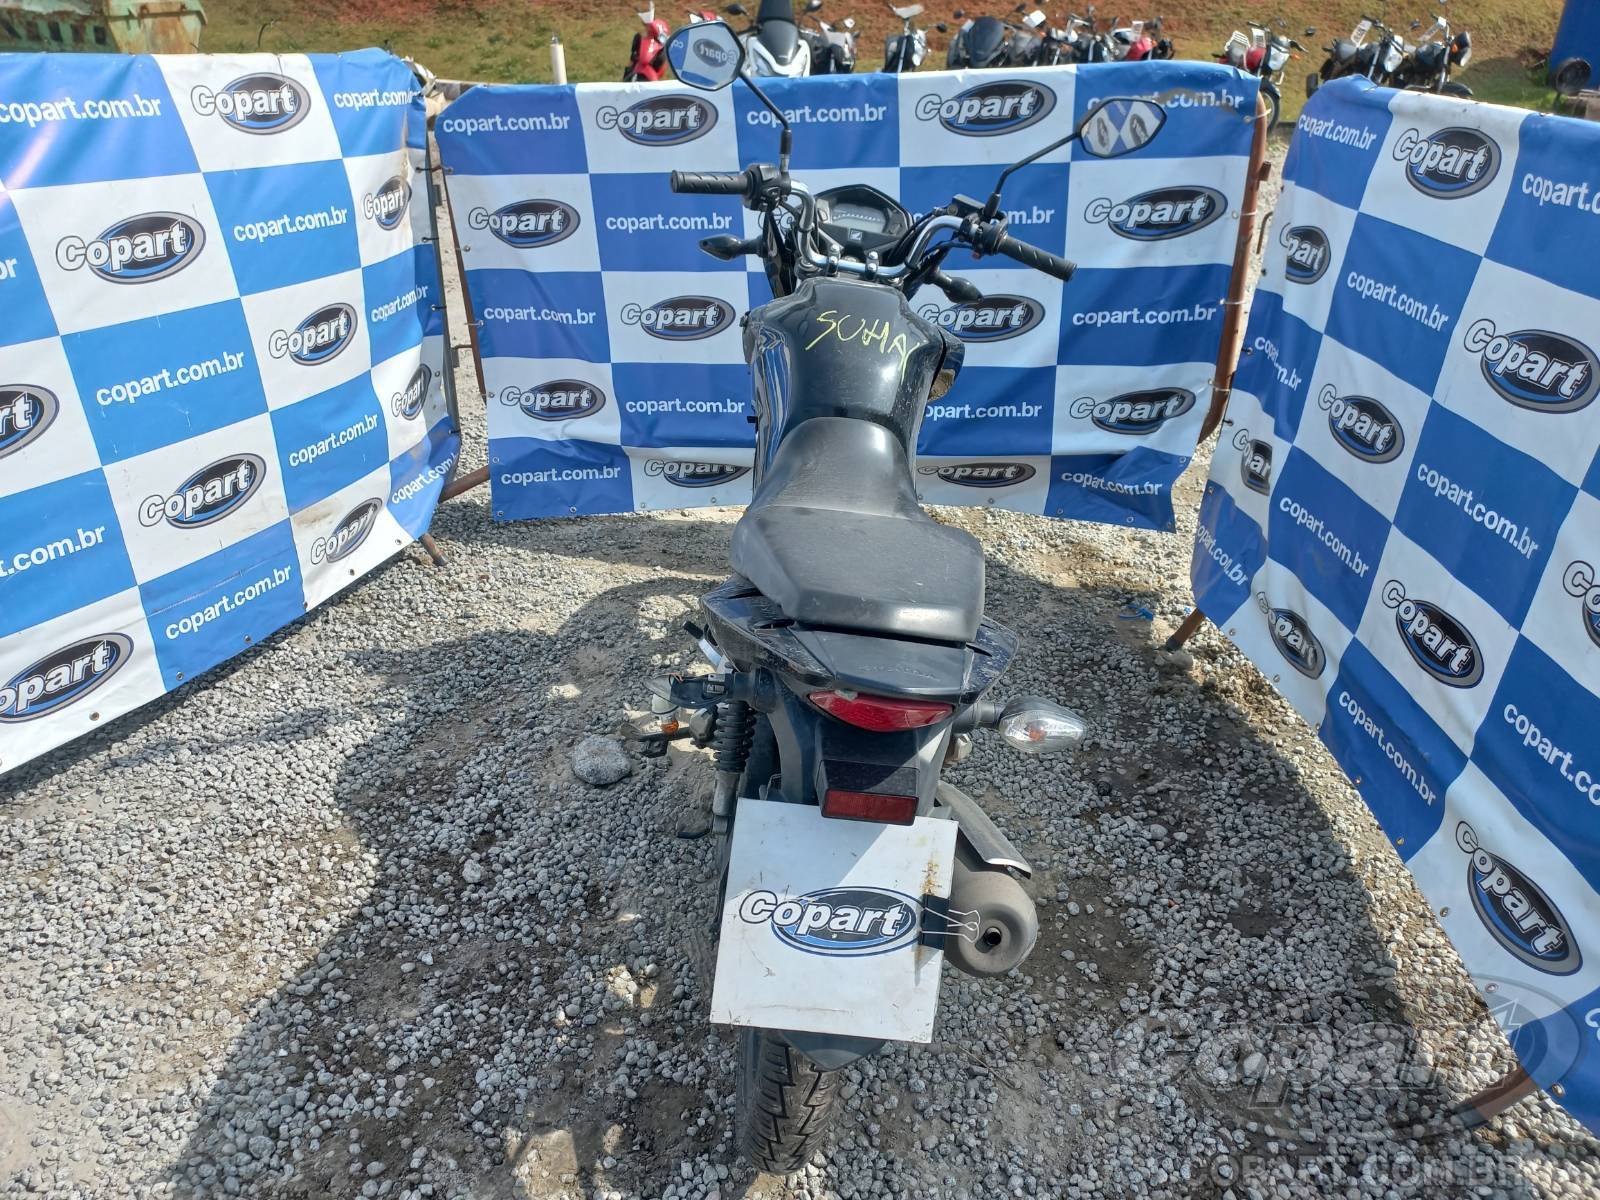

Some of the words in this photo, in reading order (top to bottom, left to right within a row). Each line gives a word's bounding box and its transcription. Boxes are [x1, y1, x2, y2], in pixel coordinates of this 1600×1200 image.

[190, 82, 296, 122] Copart
[596, 103, 701, 136] Copart
[915, 87, 1039, 126] Copart
[443, 113, 571, 136] copart.com.br
[1393, 128, 1490, 182] Copart
[233, 206, 348, 242] copart.com.br
[468, 206, 565, 237] Copart
[606, 213, 732, 233] copart.com.br
[1084, 193, 1209, 231] Copart
[56, 219, 188, 273] Copart
[483, 306, 597, 325] copart.com.br
[620, 302, 720, 331] Copart
[1072, 304, 1217, 328] copart.com.br
[1347, 271, 1449, 332] copart.com.br
[268, 307, 350, 359] Copart
[96, 352, 245, 404] copart.com.br
[1463, 318, 1591, 400] Copart
[500, 386, 592, 412] Copart
[625, 398, 746, 415] copart.com.br
[925, 402, 1043, 421] opart.com.br
[1069, 394, 1185, 423] Copart
[1317, 383, 1394, 454] Copart
[289, 413, 379, 468] copart.com.br
[501, 465, 621, 486] copart.com.br
[918, 464, 1019, 479] Copart
[138, 459, 251, 529] Copart
[1417, 463, 1540, 560] copart.com.br
[1279, 496, 1370, 579] copart.com.br
[165, 566, 292, 640] copart.com.br
[1381, 579, 1474, 674] Copart
[1338, 690, 1437, 807] copart.com.br
[1455, 820, 1565, 956] Copart
[739, 890, 909, 937] Copart
